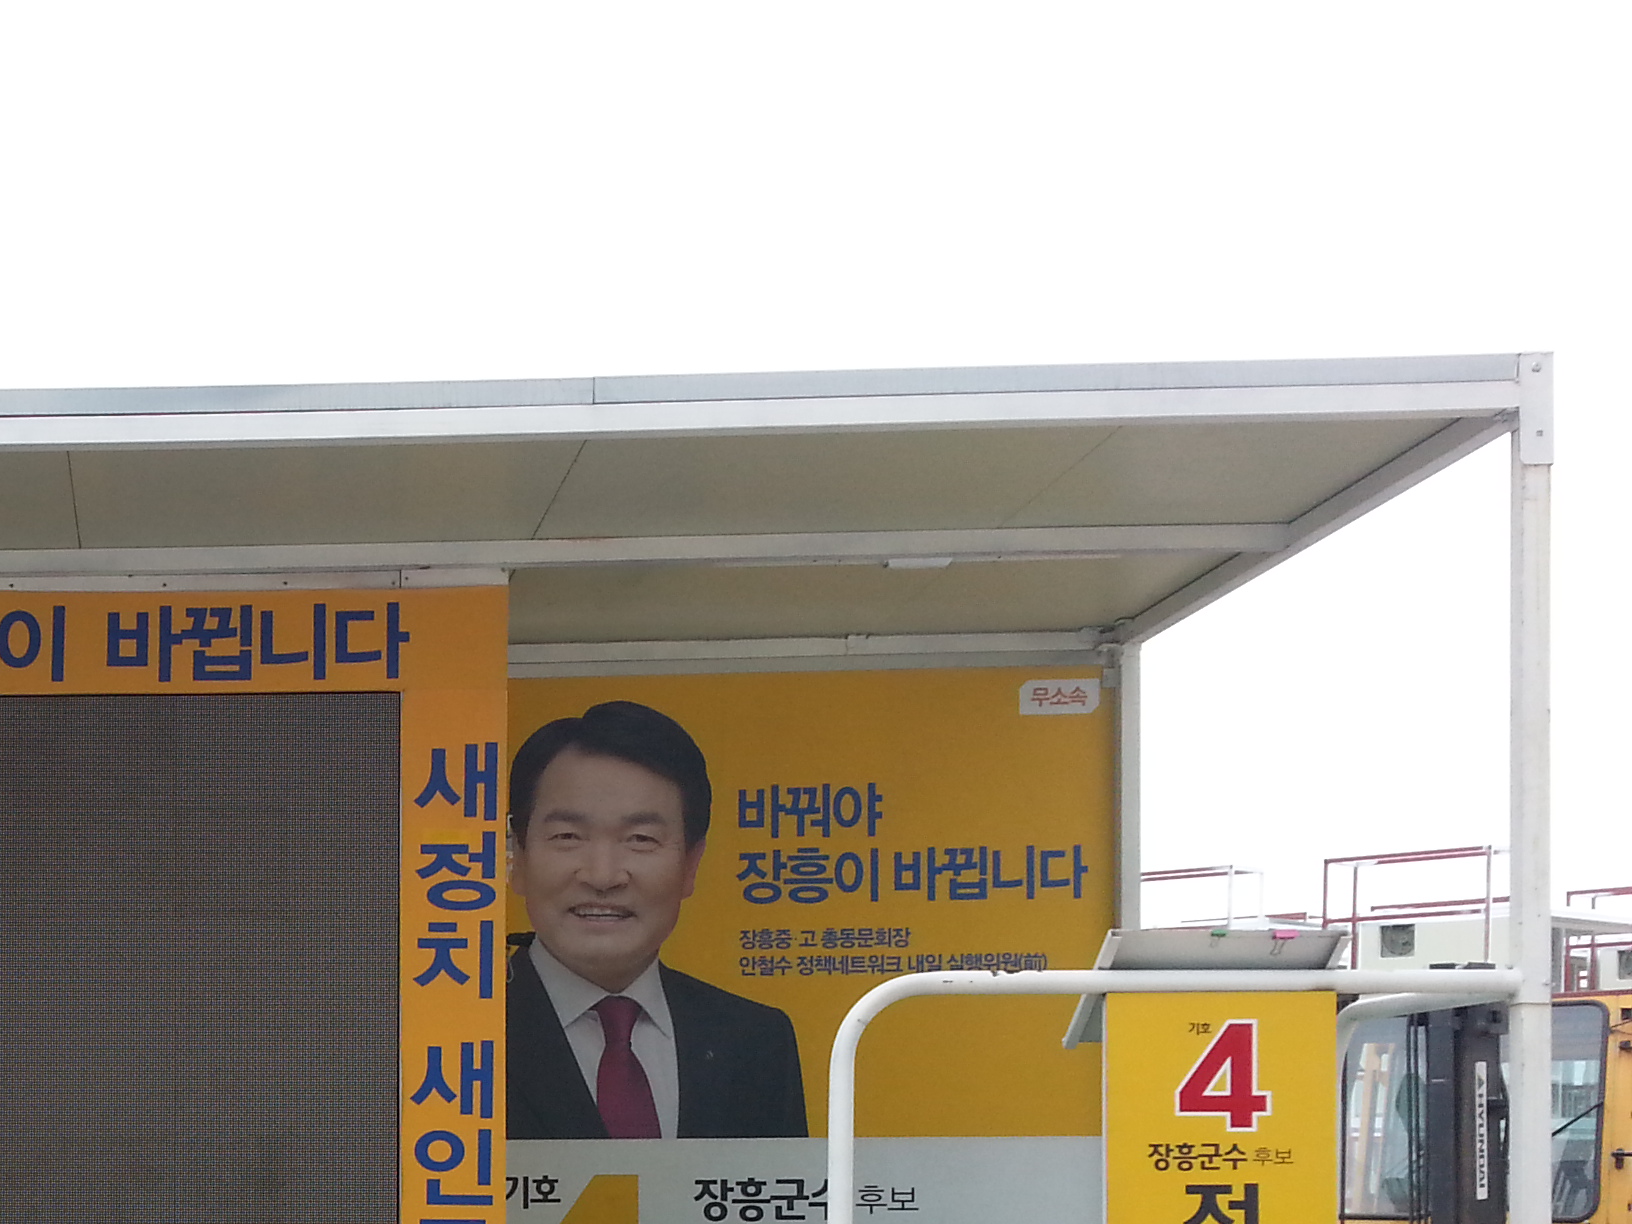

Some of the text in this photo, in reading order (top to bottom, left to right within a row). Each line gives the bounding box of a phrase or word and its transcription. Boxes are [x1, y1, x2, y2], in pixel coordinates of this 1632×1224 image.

[106, 602, 410, 681] 바뀝니다
[1031, 685, 1088, 707] 무소속
[738, 783, 883, 838] 바꿔야
[414, 742, 499, 999] 새정치
[736, 844, 1089, 904] 장흥이 바뀝니다
[820, 928, 911, 948] 총동문회장
[739, 955, 793, 976] 안철수
[796, 954, 904, 975] 정책네트워크
[907, 954, 943, 972] 내일
[1174, 1018, 1272, 1132] 기호 4
[1147, 1142, 1294, 1171] 장흥군수 후보
[1477, 1092, 1486, 1188] HYUNDAI
[506, 1176, 561, 1209] 기호
[857, 1185, 919, 1214] 후보
